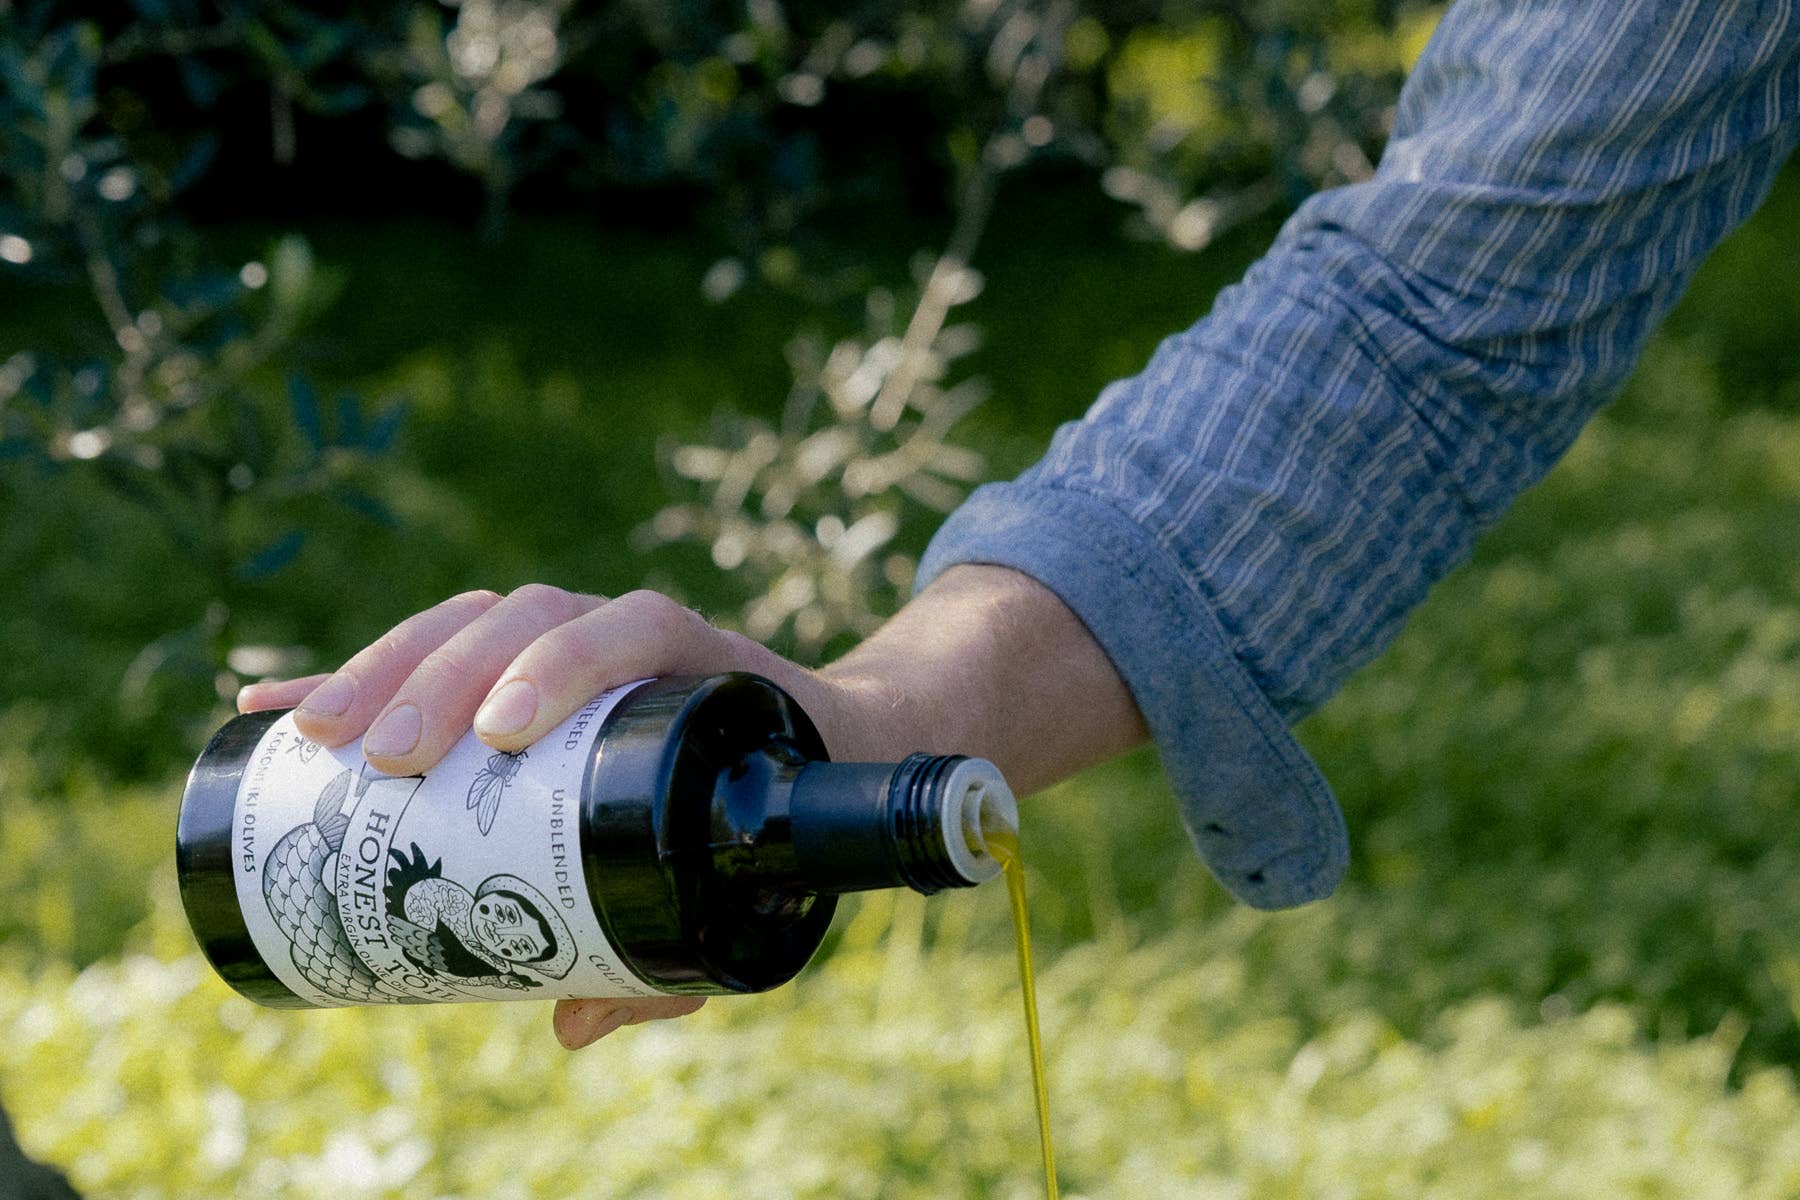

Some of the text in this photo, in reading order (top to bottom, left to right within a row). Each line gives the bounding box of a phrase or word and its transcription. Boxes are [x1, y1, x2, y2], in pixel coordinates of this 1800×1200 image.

[242, 731, 288, 873] KORONIKI OLIVES
[337, 854, 410, 992] EXTRA VIRGIN OLIVE OIL
[354, 809, 457, 999] HONEST TOIL
[550, 789, 575, 910] UNBLENDED
[589, 955, 625, 985] COLD
